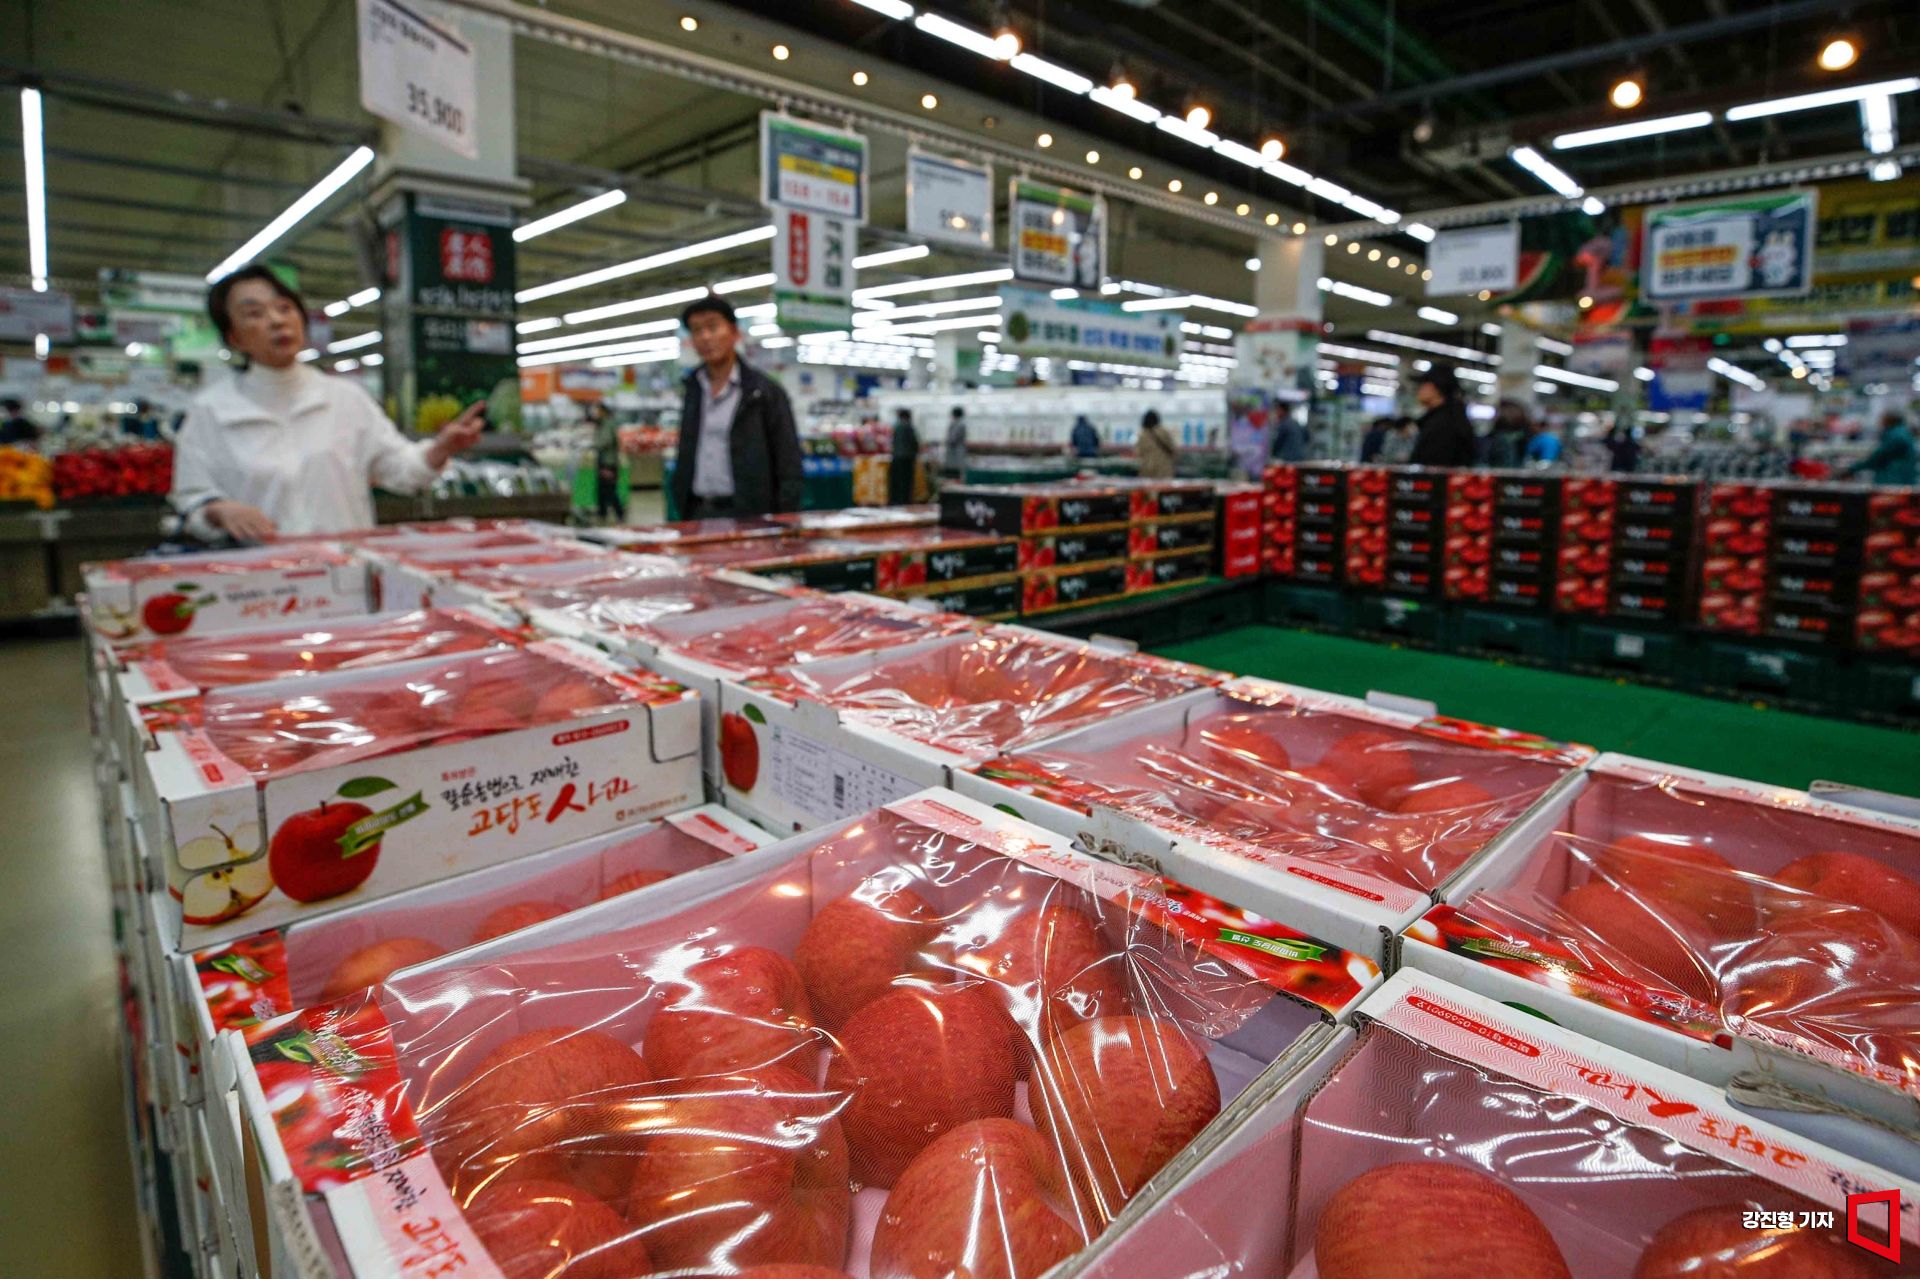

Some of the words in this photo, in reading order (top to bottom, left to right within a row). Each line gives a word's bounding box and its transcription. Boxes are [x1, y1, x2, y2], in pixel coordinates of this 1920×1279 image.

[468, 792, 545, 836] 고당도
[545, 776, 638, 824] 사과
[1566, 1061, 1700, 1120] 사과
[1698, 1114, 1807, 1171] 고당도
